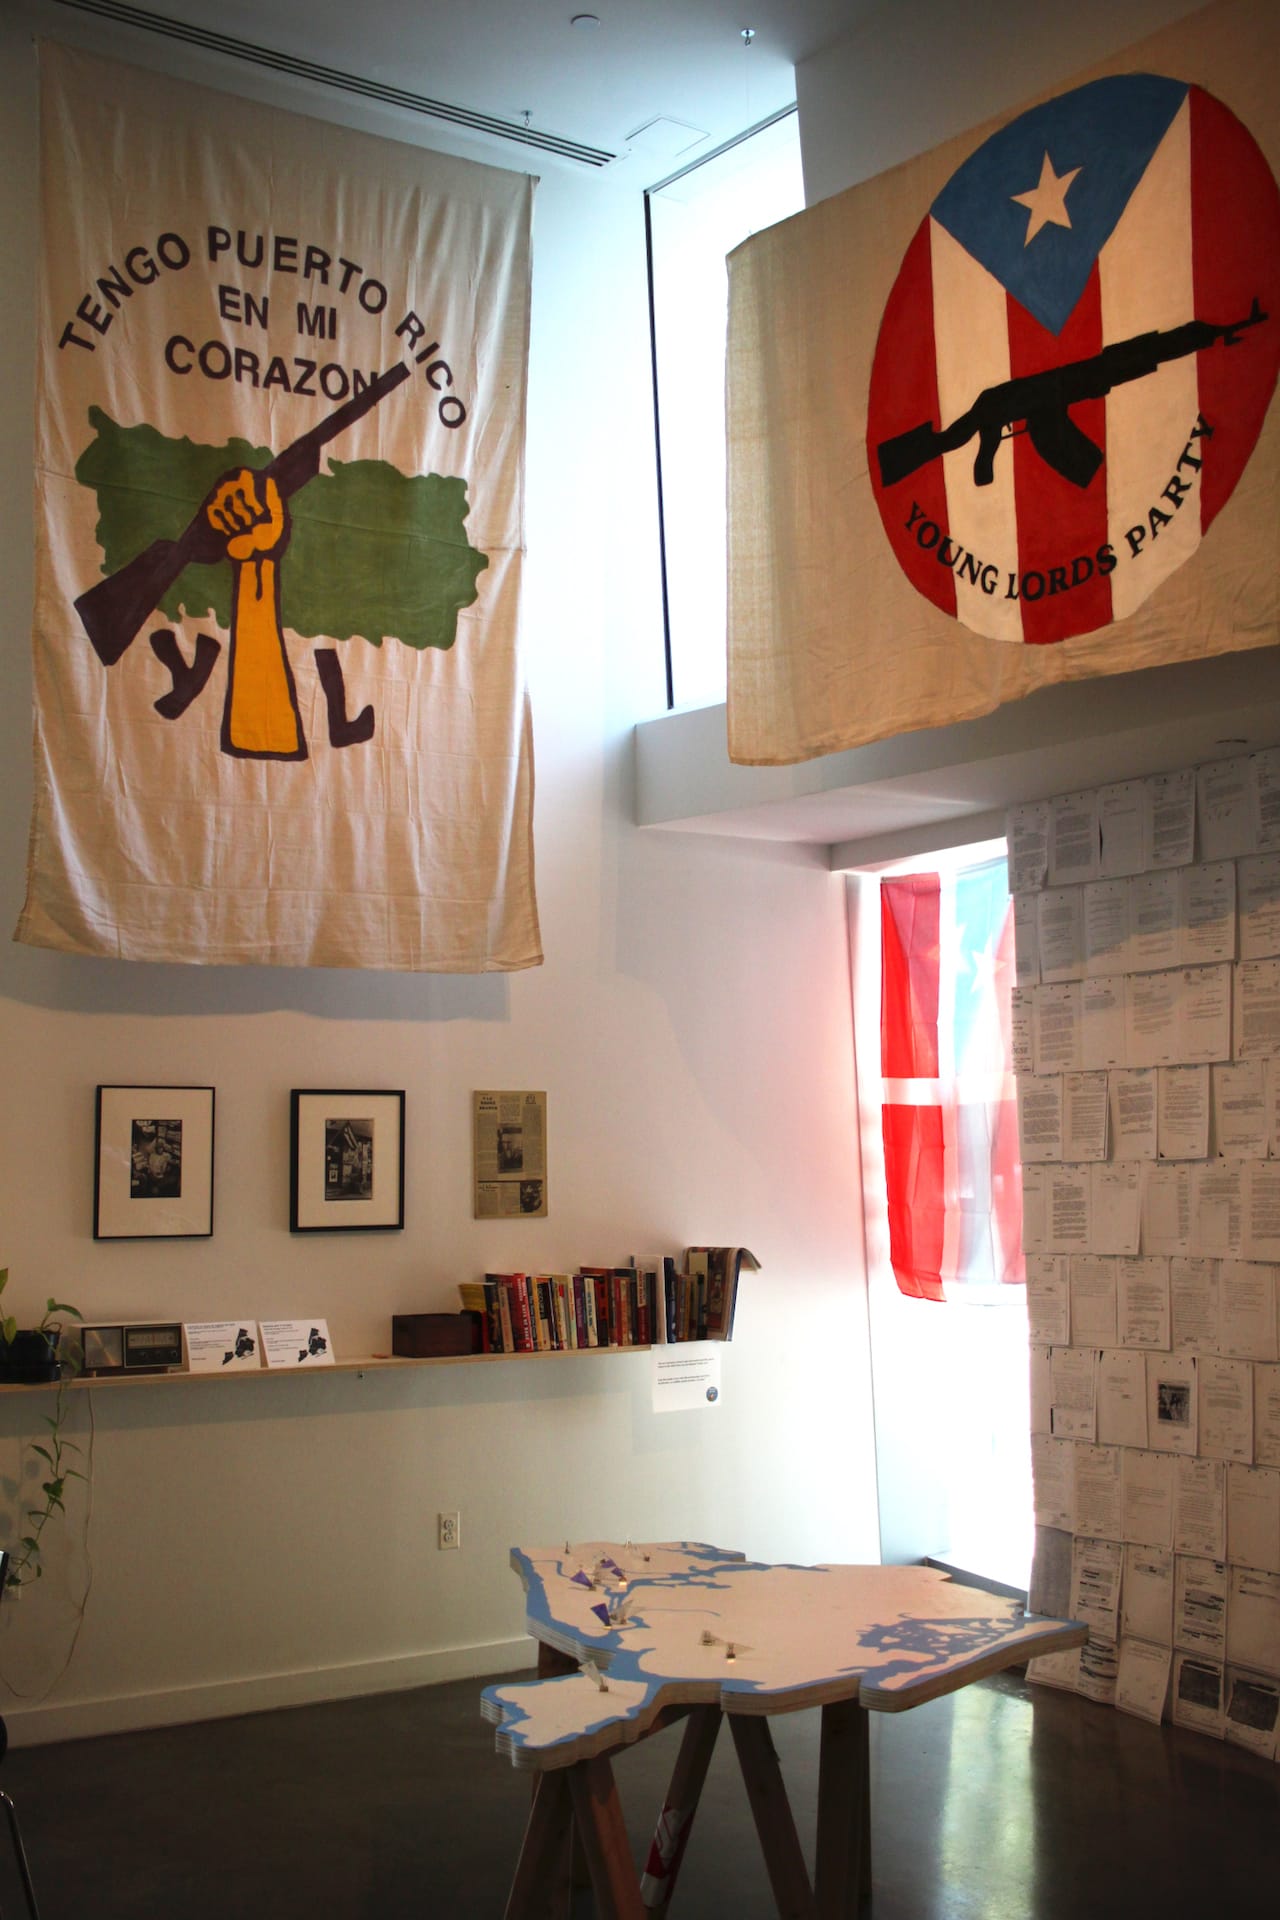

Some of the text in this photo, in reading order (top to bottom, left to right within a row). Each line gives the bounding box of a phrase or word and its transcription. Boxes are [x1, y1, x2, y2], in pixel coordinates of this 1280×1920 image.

[58, 225, 468, 430] TENGO PUERTO RICO
[164, 335, 379, 402] CORAZON
[217, 284, 338, 341] EN MI
[903, 412, 1216, 602] YOUNG LORDS PARTY
